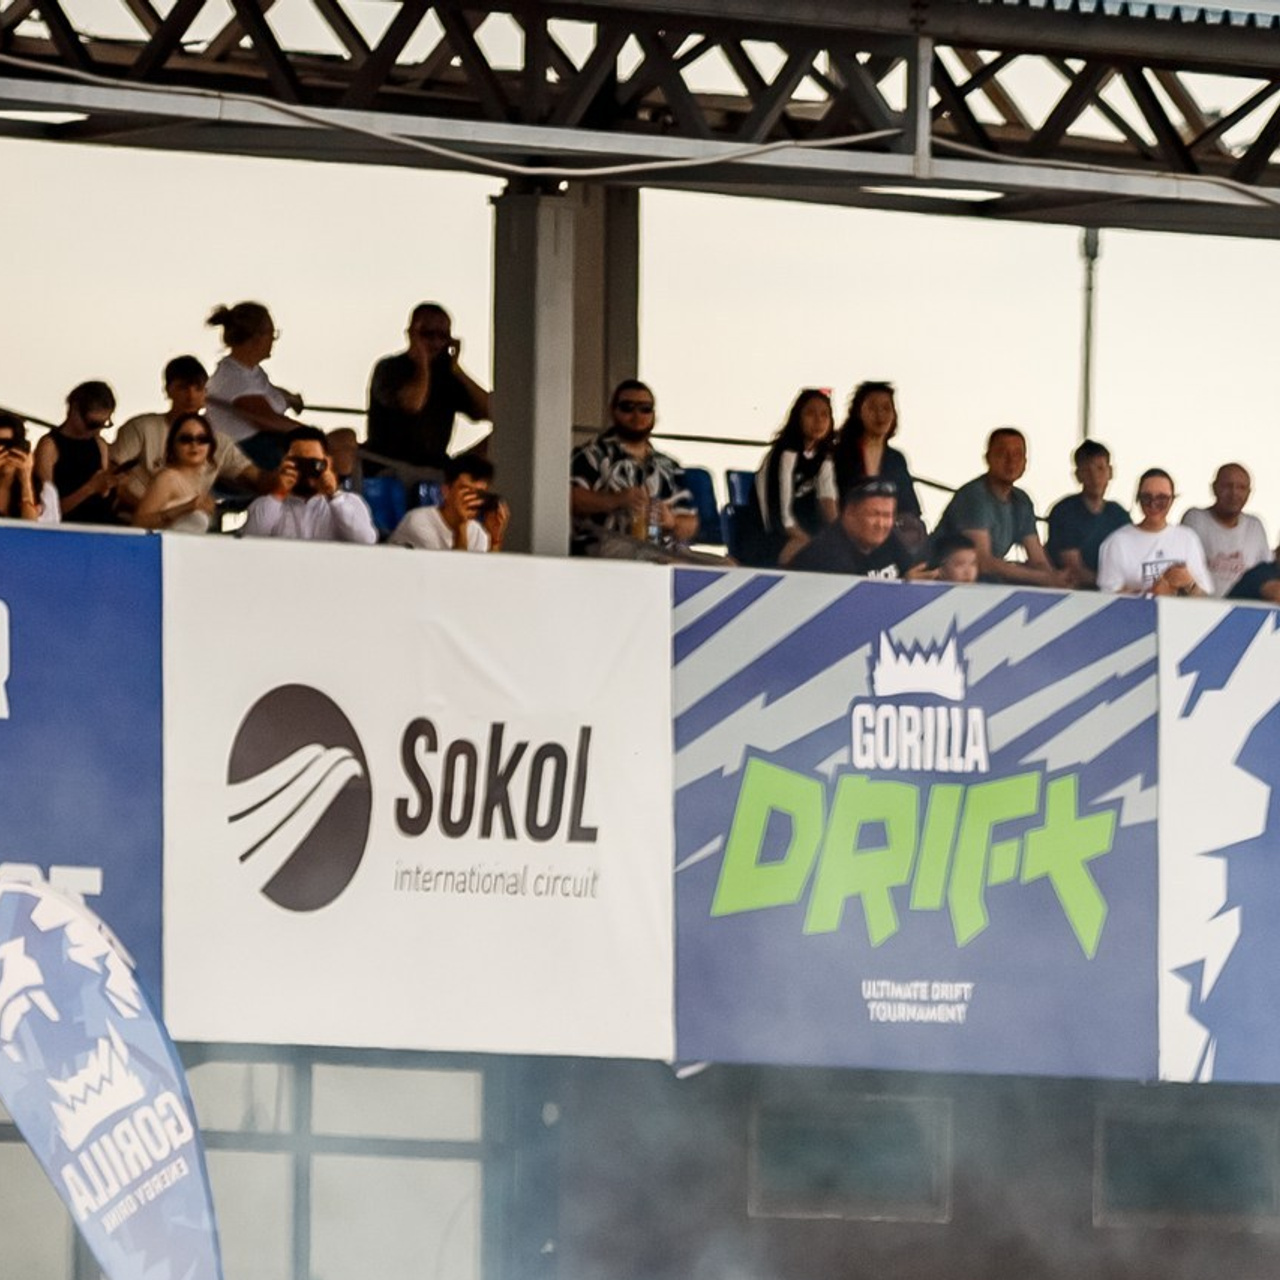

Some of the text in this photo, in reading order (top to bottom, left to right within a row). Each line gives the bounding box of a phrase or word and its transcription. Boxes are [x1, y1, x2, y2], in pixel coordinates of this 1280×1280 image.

[851, 703, 990, 773] GORILLA
[709, 756, 1117, 961] DRIFT
[393, 861, 600, 899] international circuit
[861, 980, 974, 1001] ULTIMATE DRIFT
[867, 1002, 967, 1022] TOURNAMENT
